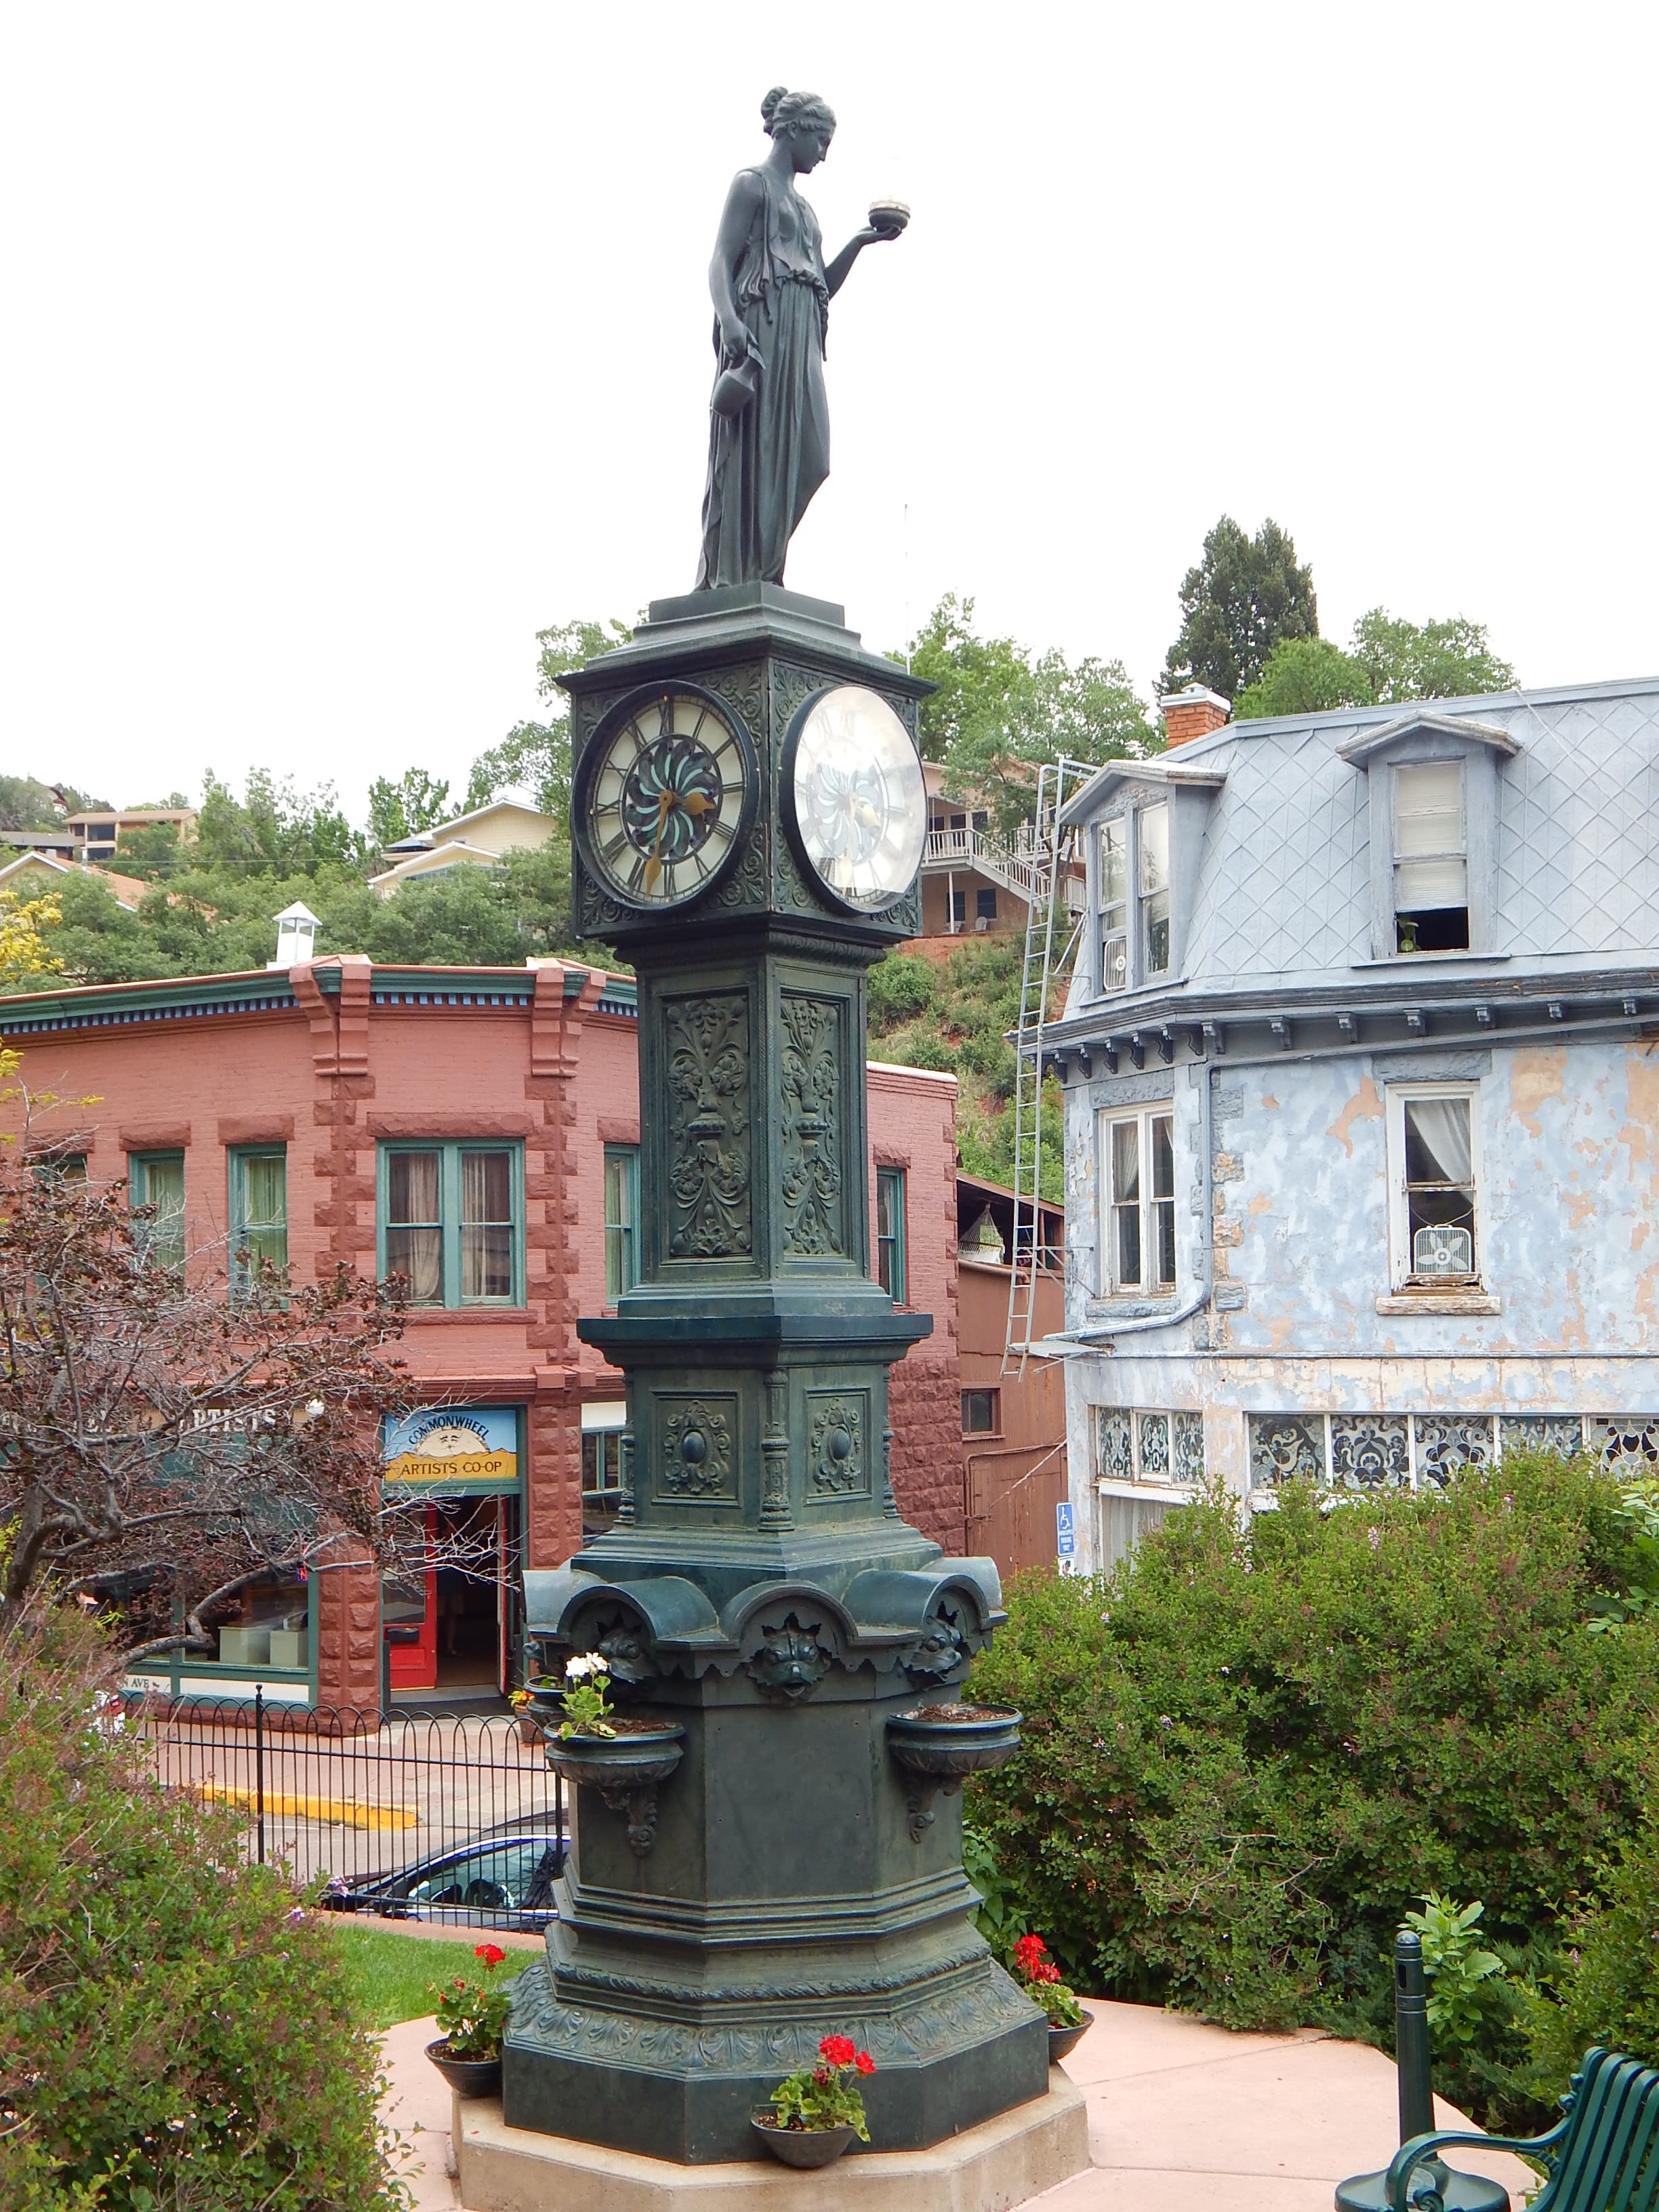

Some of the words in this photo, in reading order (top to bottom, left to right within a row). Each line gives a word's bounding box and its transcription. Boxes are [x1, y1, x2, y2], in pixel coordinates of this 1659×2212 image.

[179, 1409, 276, 1433] RTISTS
[409, 1415, 489, 1445] COMMONWHEEL
[401, 1462, 457, 1475] ARTISTS
[462, 1461, 502, 1473] CO-OP
[131, 1678, 149, 1688] AVE
